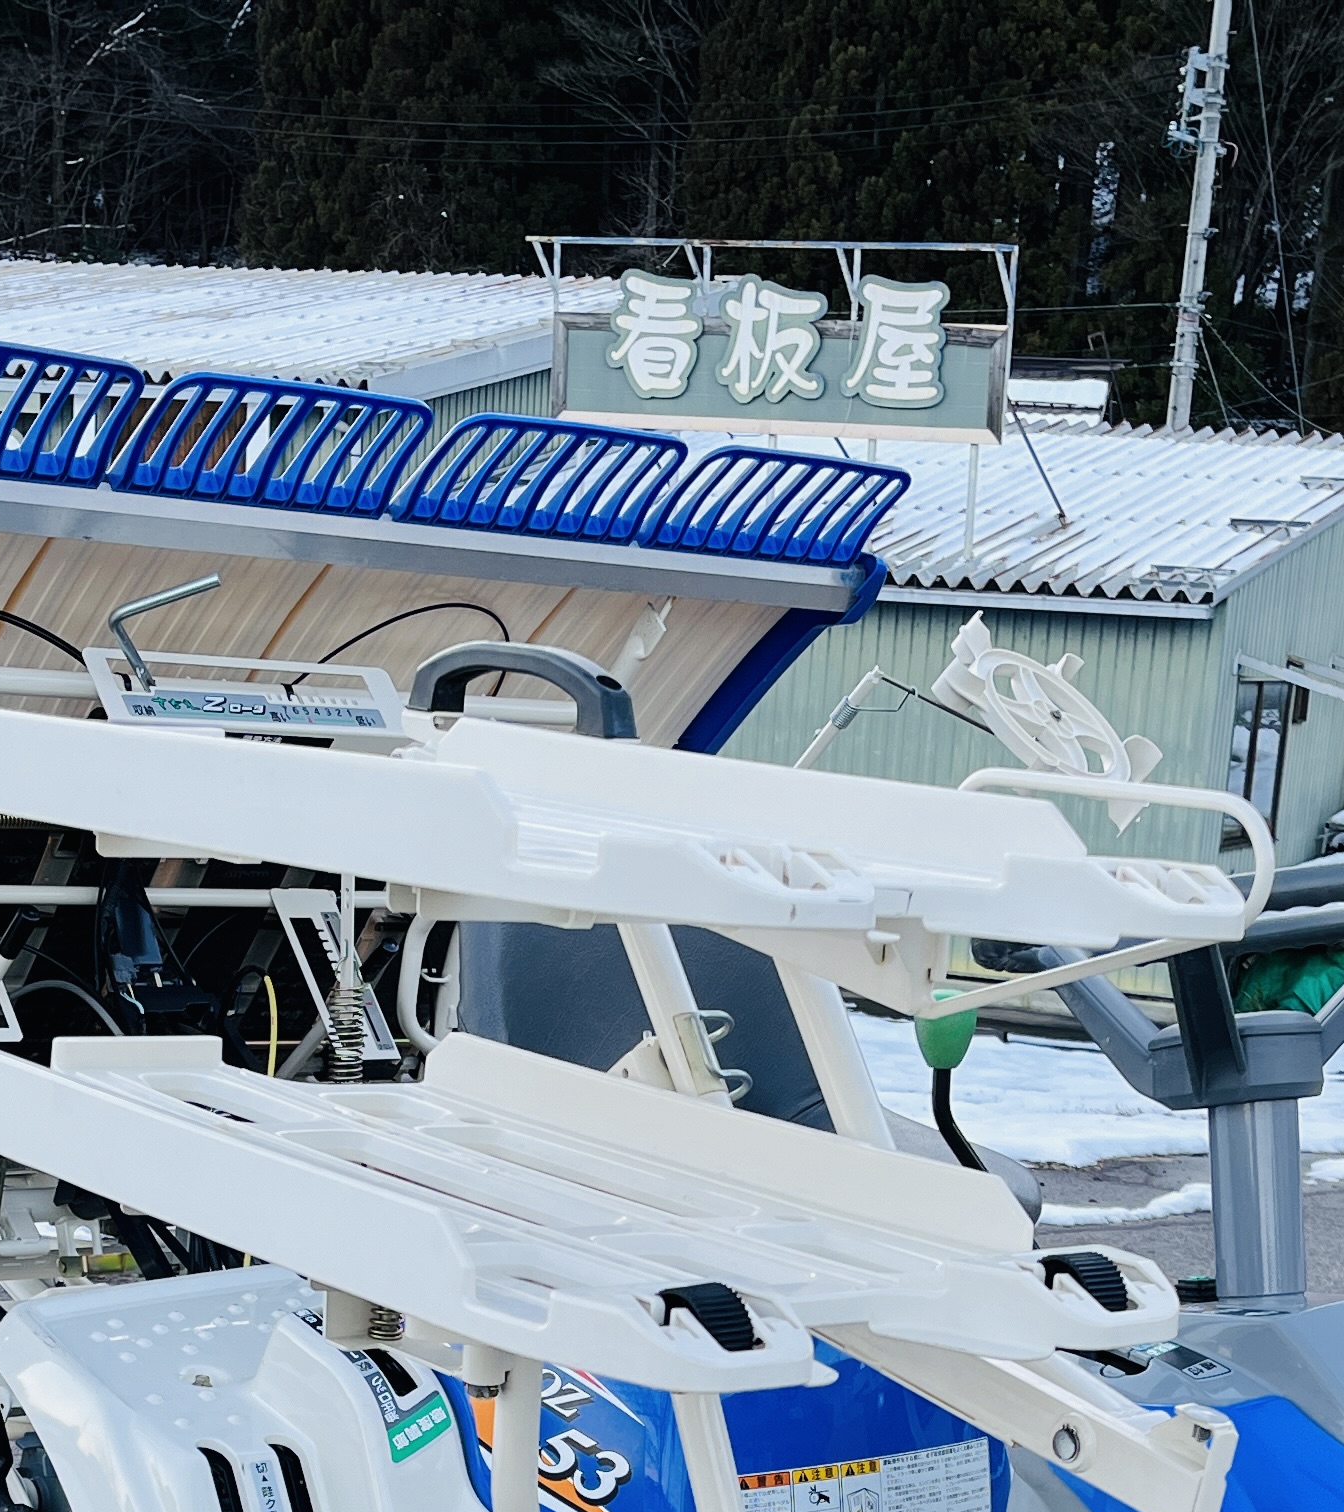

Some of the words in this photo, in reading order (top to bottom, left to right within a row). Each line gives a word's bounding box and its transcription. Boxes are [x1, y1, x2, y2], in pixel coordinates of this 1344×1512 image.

[609, 271, 948, 405] 看板屋
[255, 1463, 268, 1473] 切
[538, 1428, 631, 1503] 53
